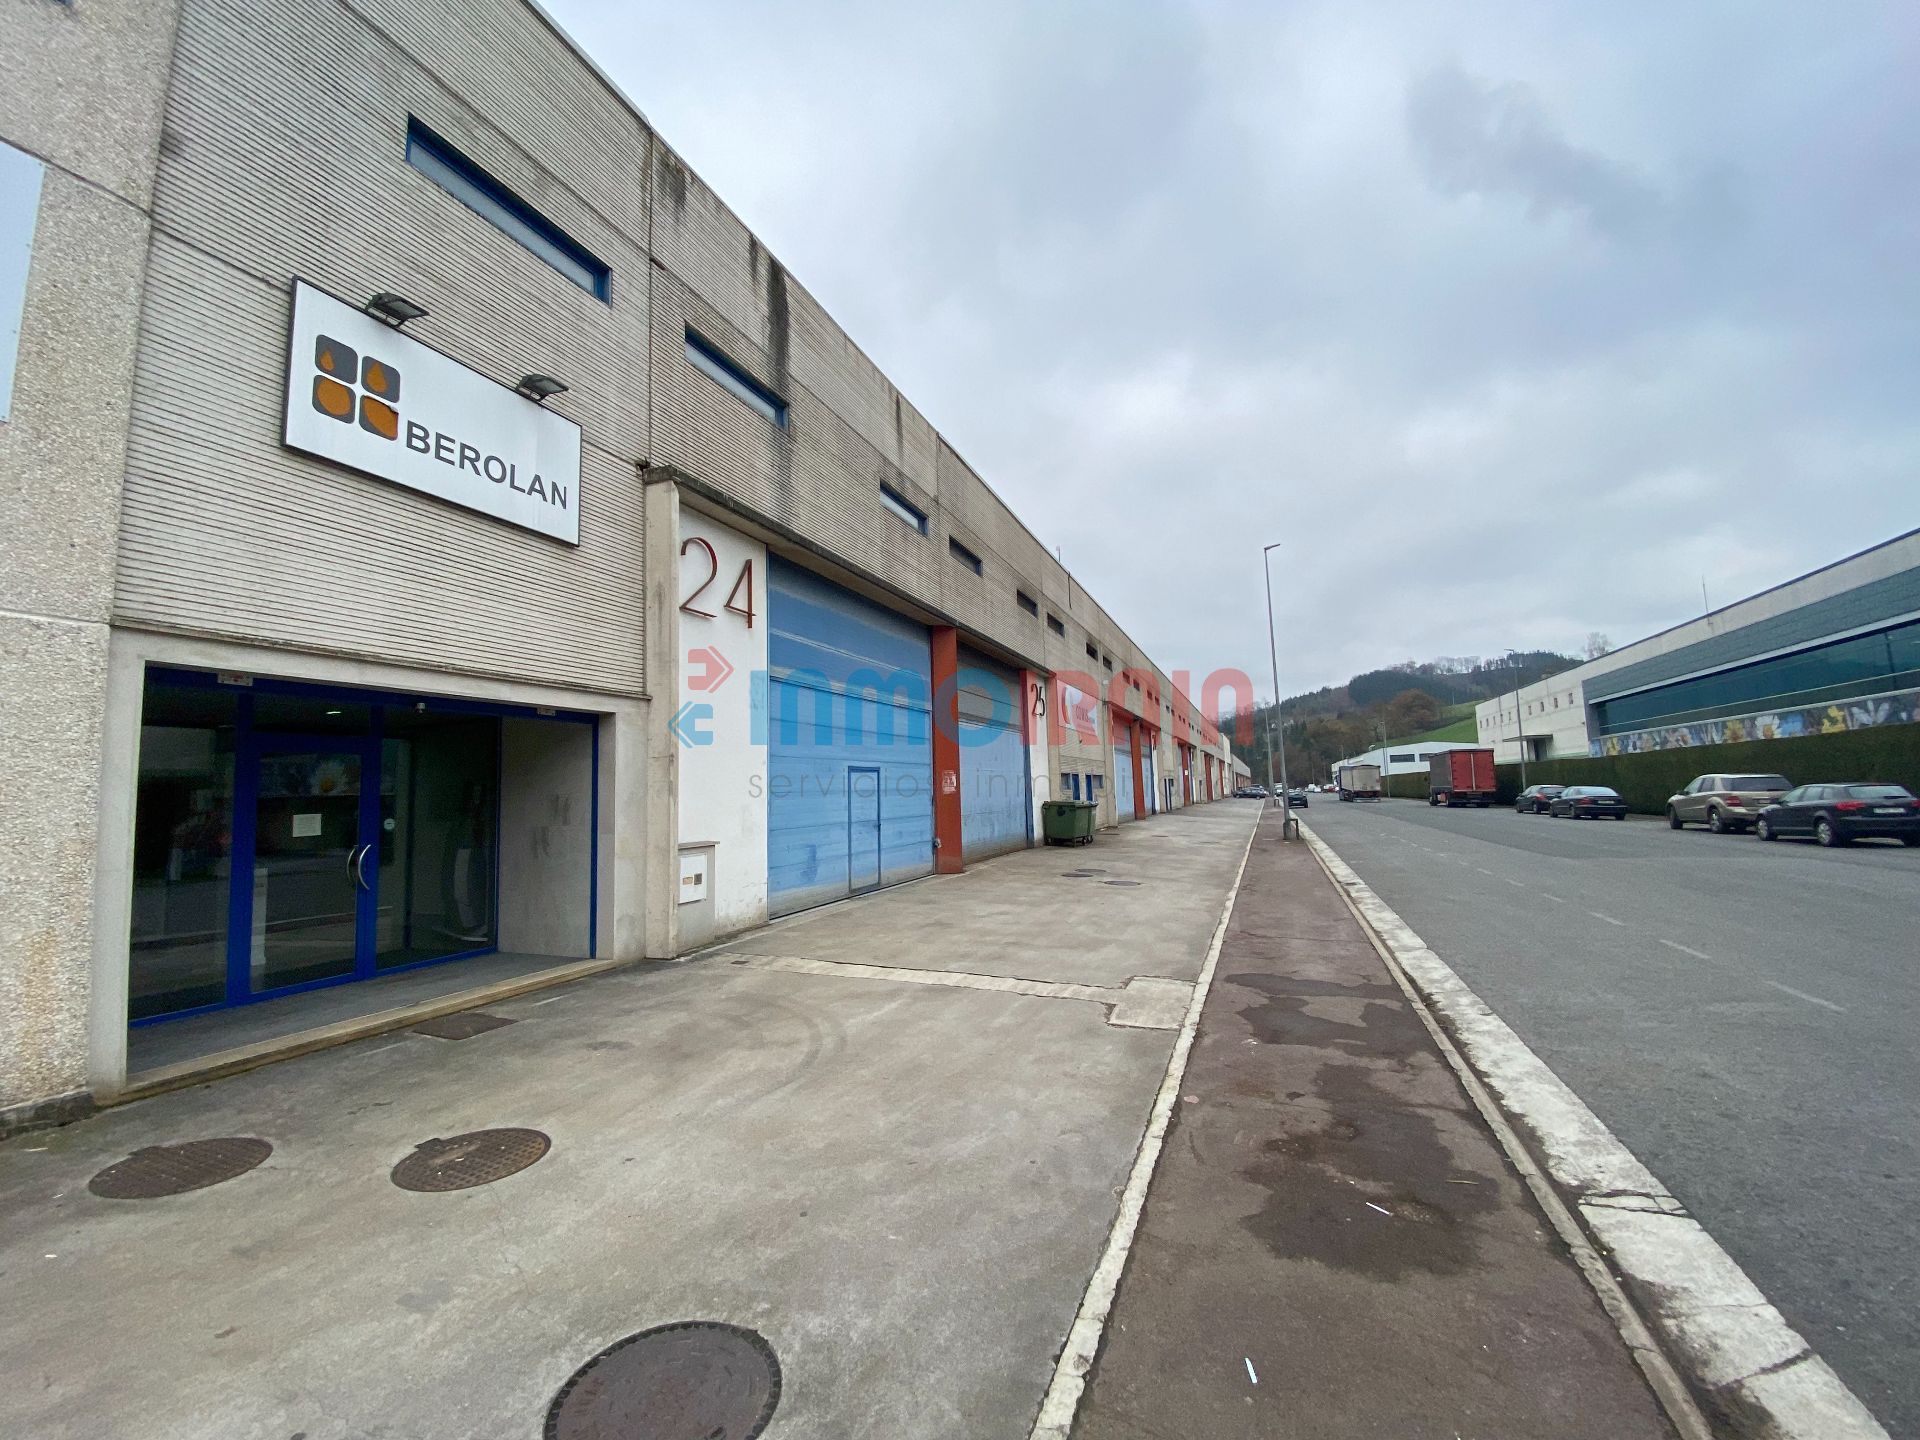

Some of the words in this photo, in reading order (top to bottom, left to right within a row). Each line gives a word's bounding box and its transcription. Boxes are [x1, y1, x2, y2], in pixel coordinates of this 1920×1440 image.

[406, 419, 567, 510] BEROLAN
[679, 536, 757, 629] 24
[1030, 683, 1046, 717] 25
